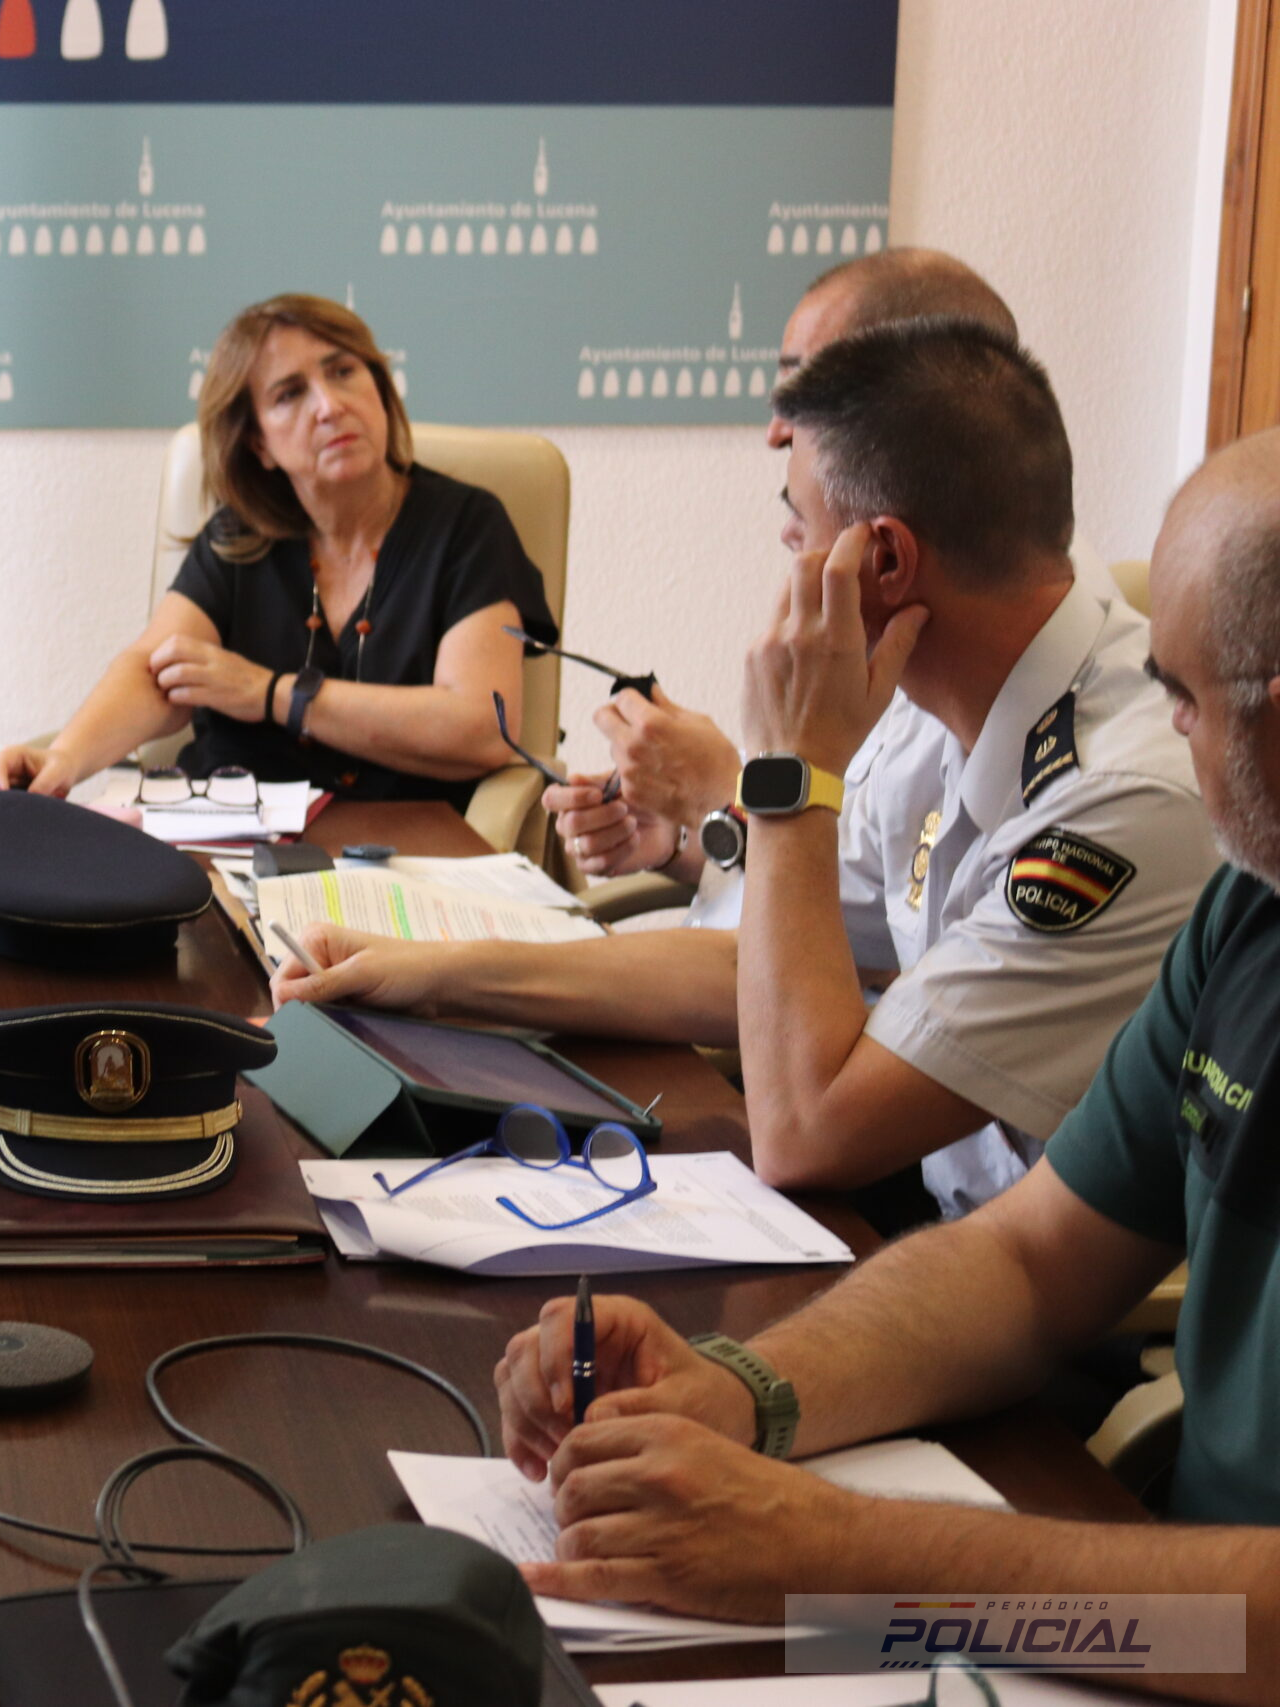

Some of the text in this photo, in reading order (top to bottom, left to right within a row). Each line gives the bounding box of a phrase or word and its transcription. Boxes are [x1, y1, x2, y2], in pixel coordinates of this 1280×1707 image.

[115, 202, 137, 218] de
[143, 203, 205, 218] Lucena
[381, 202, 597, 221] Ayuntamiento de Lucena
[579, 346, 781, 365] Ayuntamiento de Lucen
[1052, 851, 1067, 864] DE
[1061, 842, 1116, 877] NACIONAL
[1016, 885, 1079, 920] POLICIA
